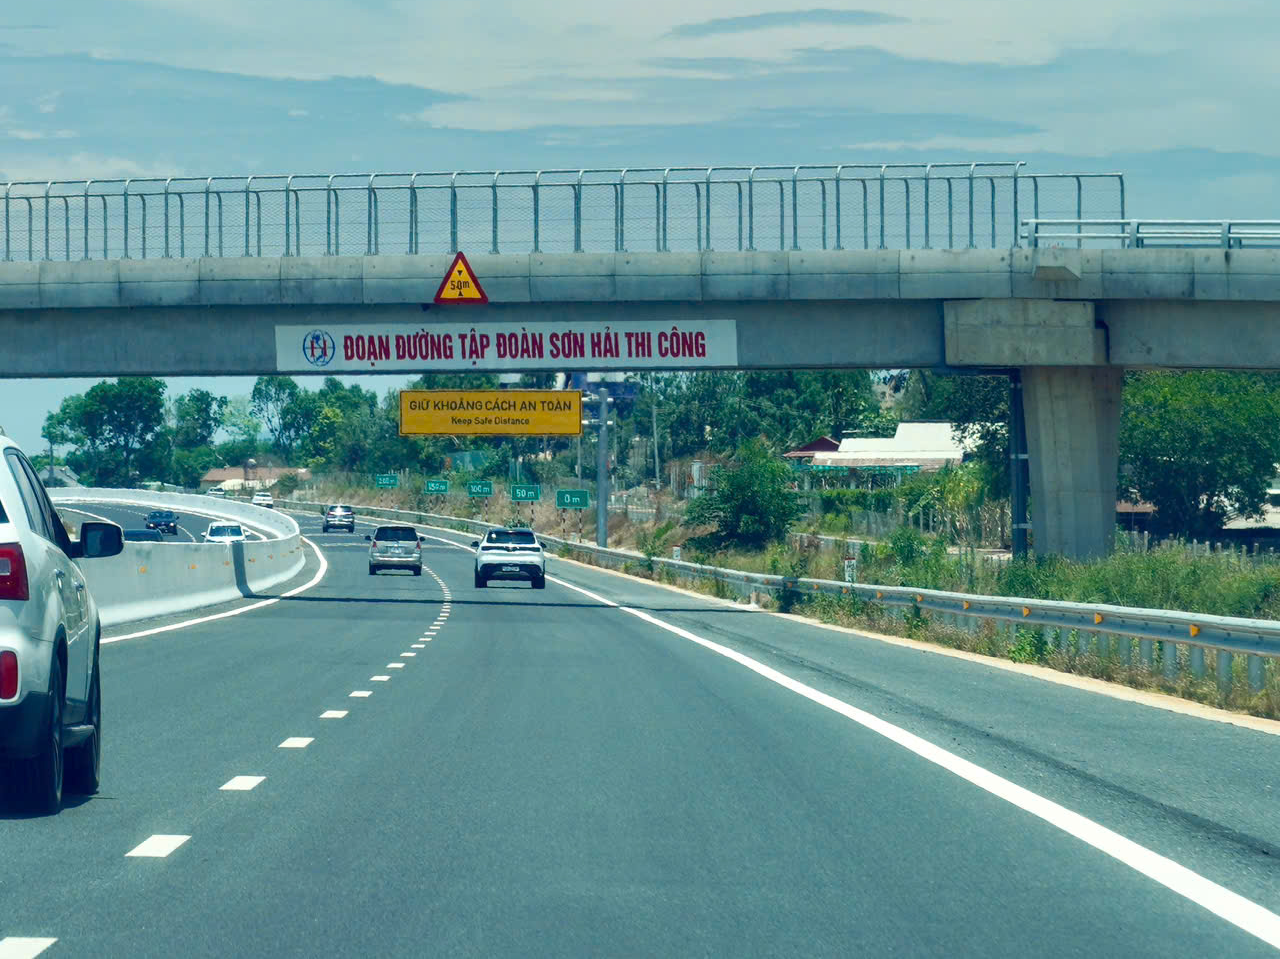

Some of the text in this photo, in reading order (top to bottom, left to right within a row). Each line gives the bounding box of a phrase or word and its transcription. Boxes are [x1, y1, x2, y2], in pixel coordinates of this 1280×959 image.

[343, 326, 706, 367] ĐOẠN ĐƯỜNG TẬP ĐOÀN SƠN HẢI THI CÔNG
[409, 398, 572, 411] GIỮ KHOẢNG CÁCH AN TOÀN
[451, 416, 530, 426] Keep Safe Distance
[516, 489, 526, 497] 50
